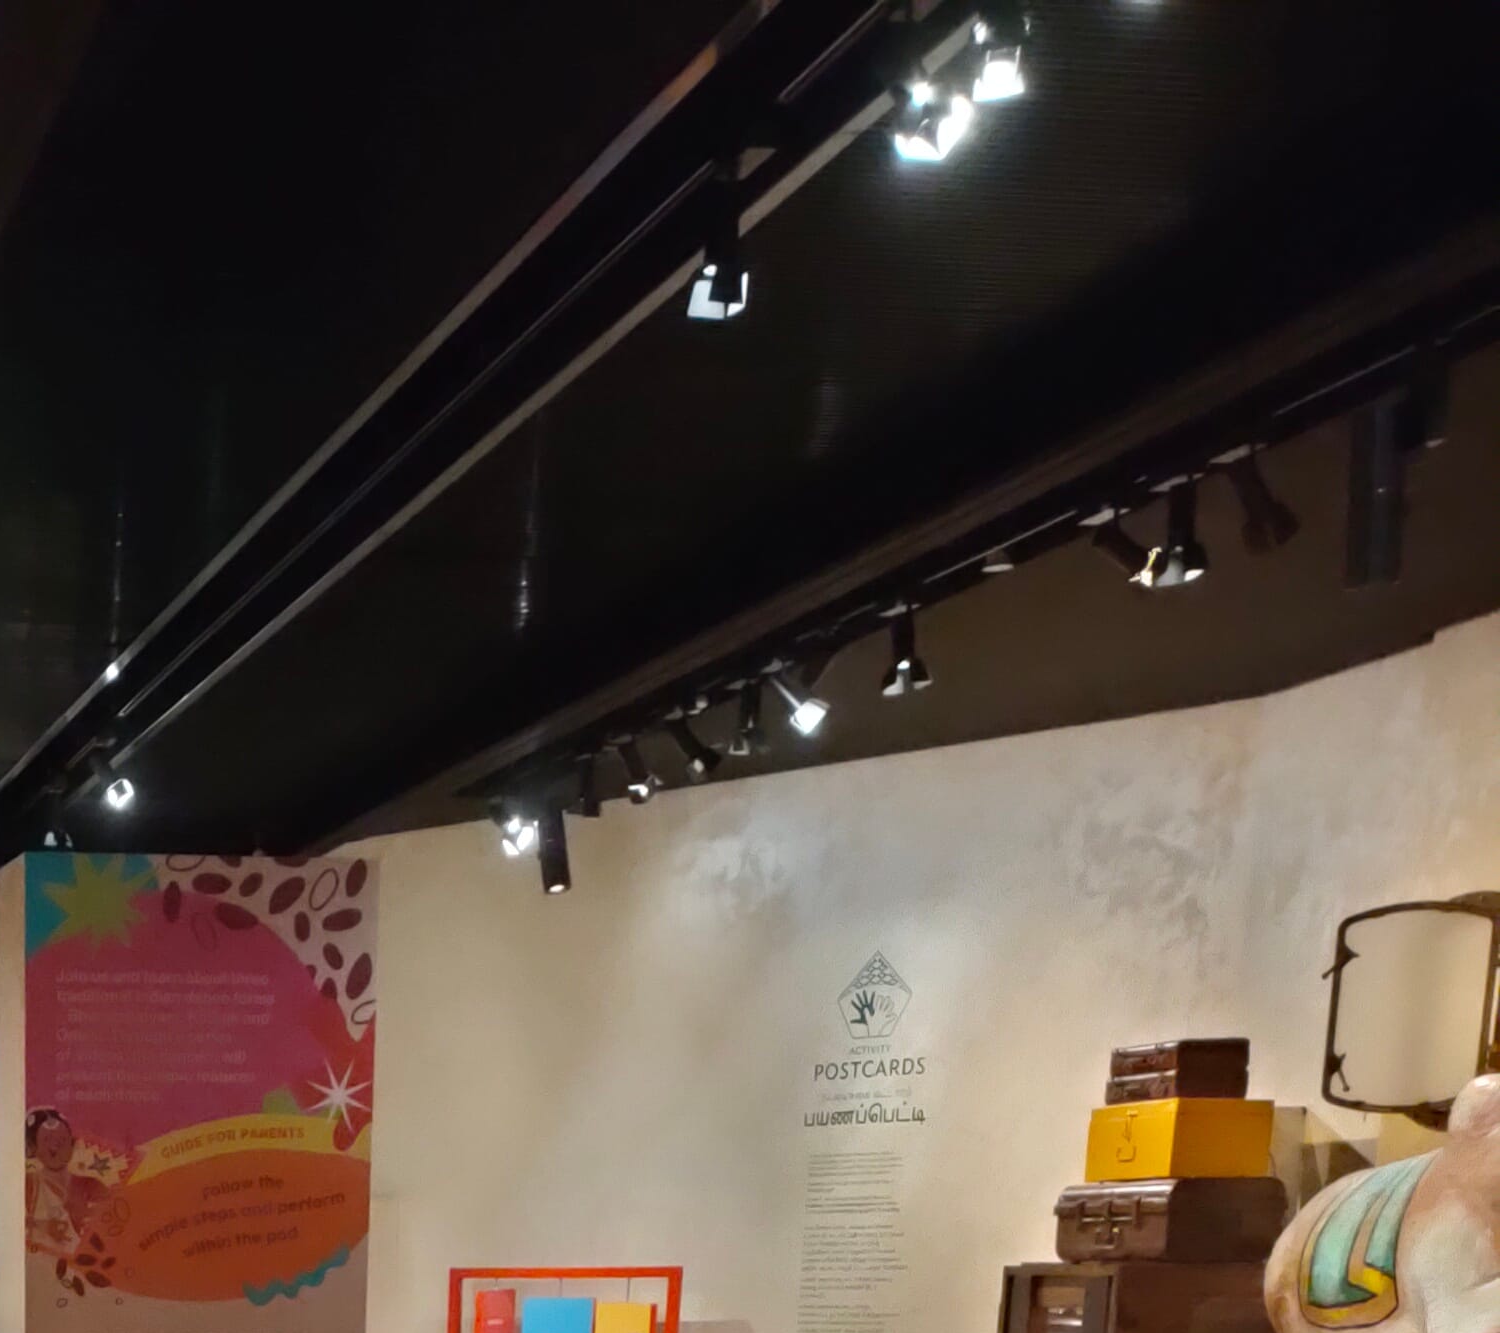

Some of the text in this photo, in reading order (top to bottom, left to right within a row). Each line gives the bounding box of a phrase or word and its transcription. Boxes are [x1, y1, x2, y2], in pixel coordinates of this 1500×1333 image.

[813, 1056, 927, 1082] POSTCARDS
[160, 1126, 305, 1160] GUIDE FOR PARENTS
[258, 1175, 284, 1191] the
[137, 1191, 346, 1252] simple steps and perform
[182, 1235, 232, 1258] within
[235, 1231, 262, 1248] the
